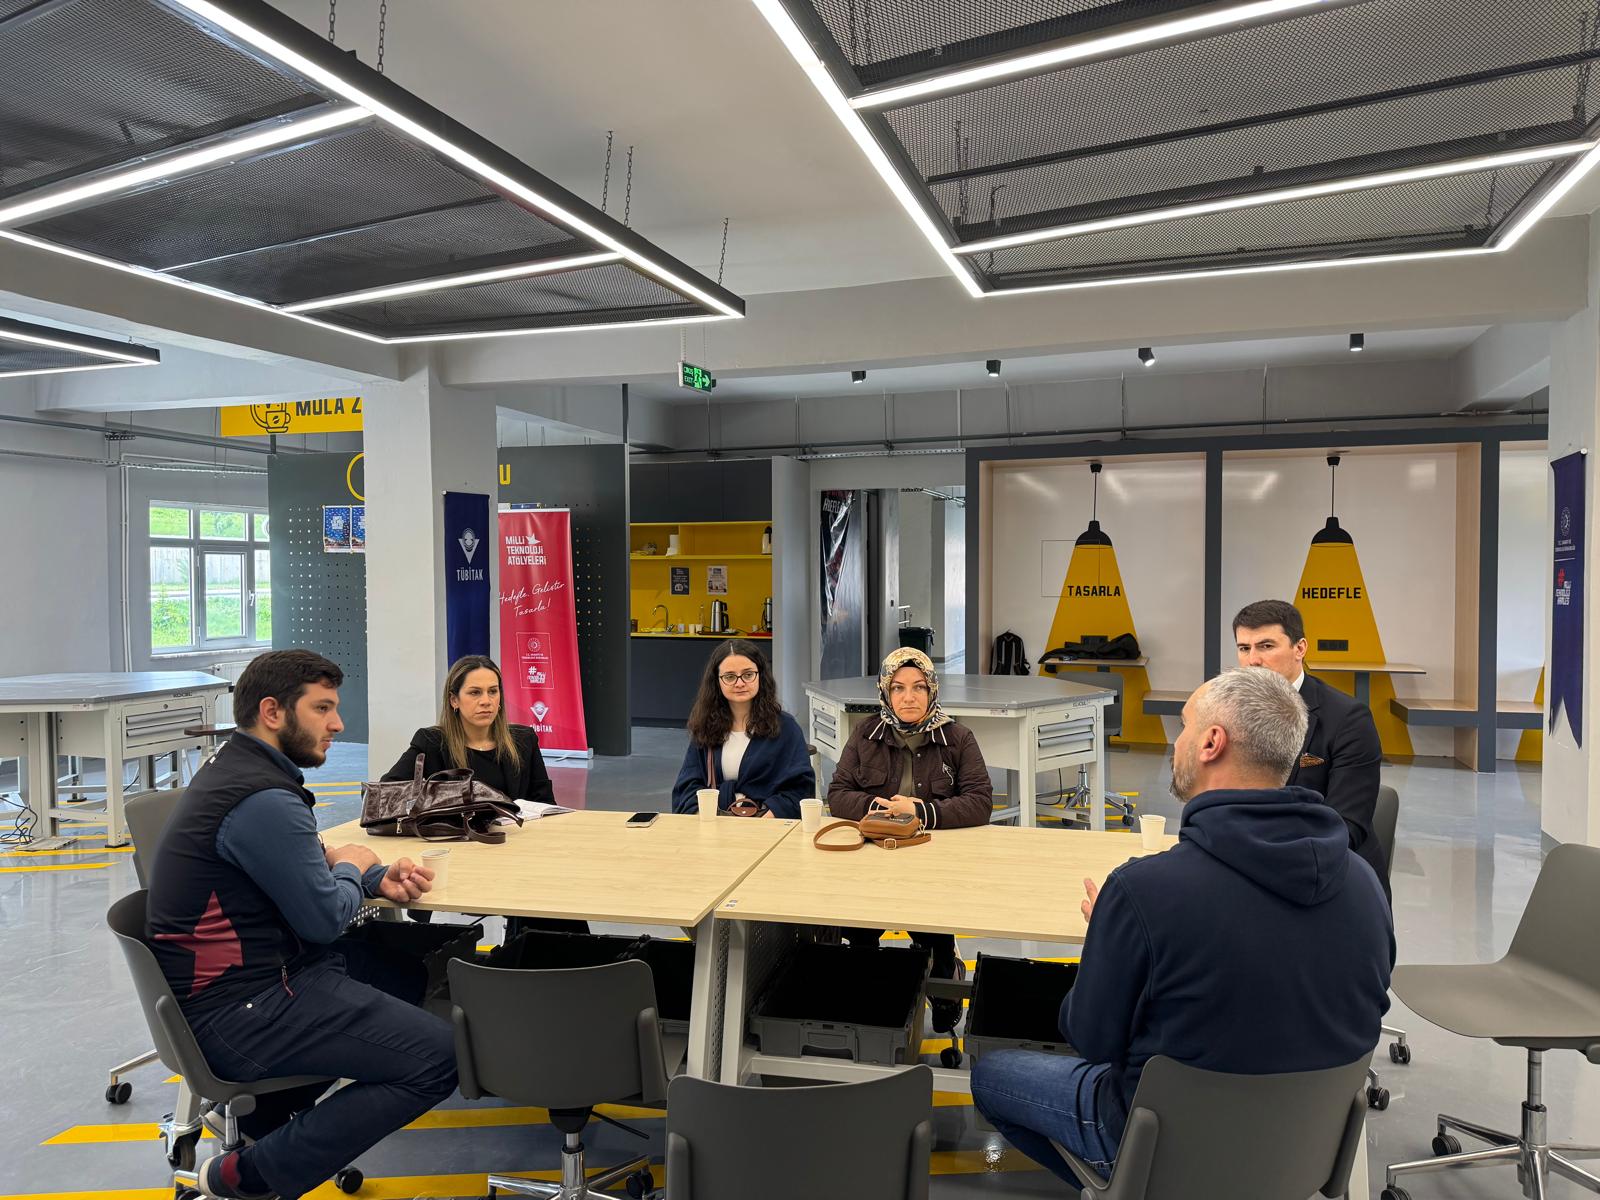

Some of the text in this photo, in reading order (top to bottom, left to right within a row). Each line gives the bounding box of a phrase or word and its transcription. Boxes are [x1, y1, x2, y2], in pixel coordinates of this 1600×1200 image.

[351, 397, 362, 414] Z
[499, 463, 511, 485] U
[456, 567, 484, 581] TÜBİTAK
[1067, 585, 1121, 597] TASARLA
[1302, 587, 1361, 599] HEDEFLE
[529, 723, 553, 733] ÜBİTAK
